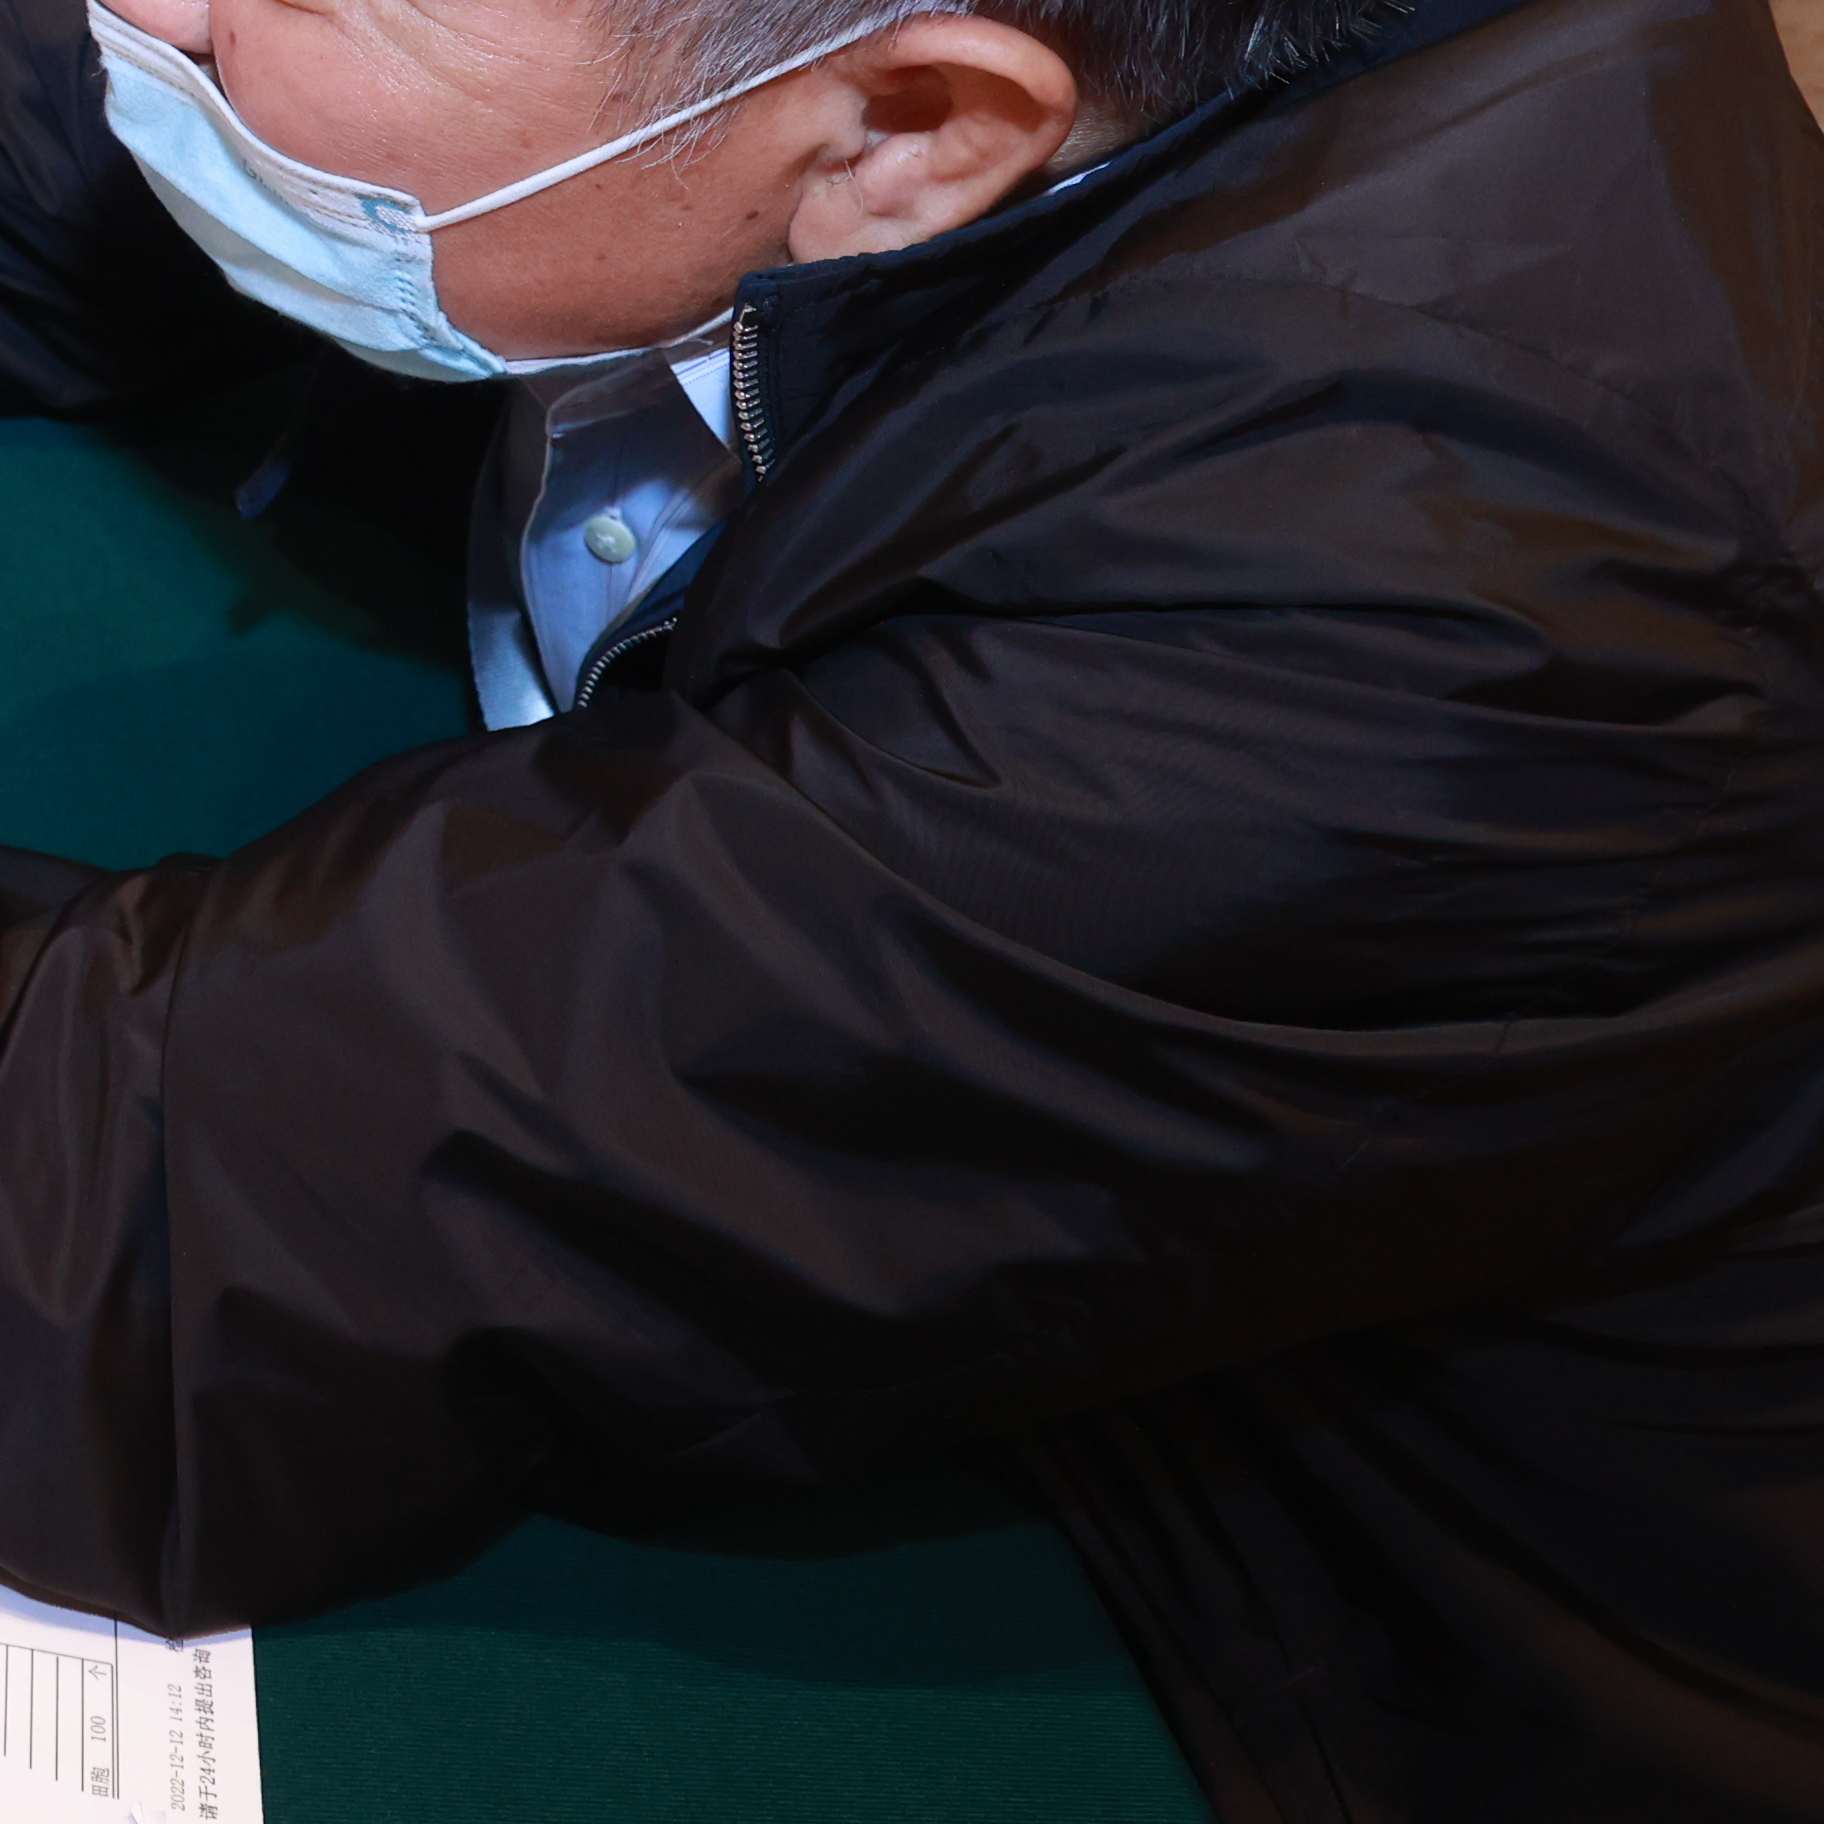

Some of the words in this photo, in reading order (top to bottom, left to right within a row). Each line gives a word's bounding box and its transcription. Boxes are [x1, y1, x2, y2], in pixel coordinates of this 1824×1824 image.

[90, 1715, 107, 1742] 100
[167, 1683, 183, 1728] 14:12
[192, 1647, 220, 1822] 请于24小时内提出咨询
[168, 1731, 186, 1812] 2022-12-12
